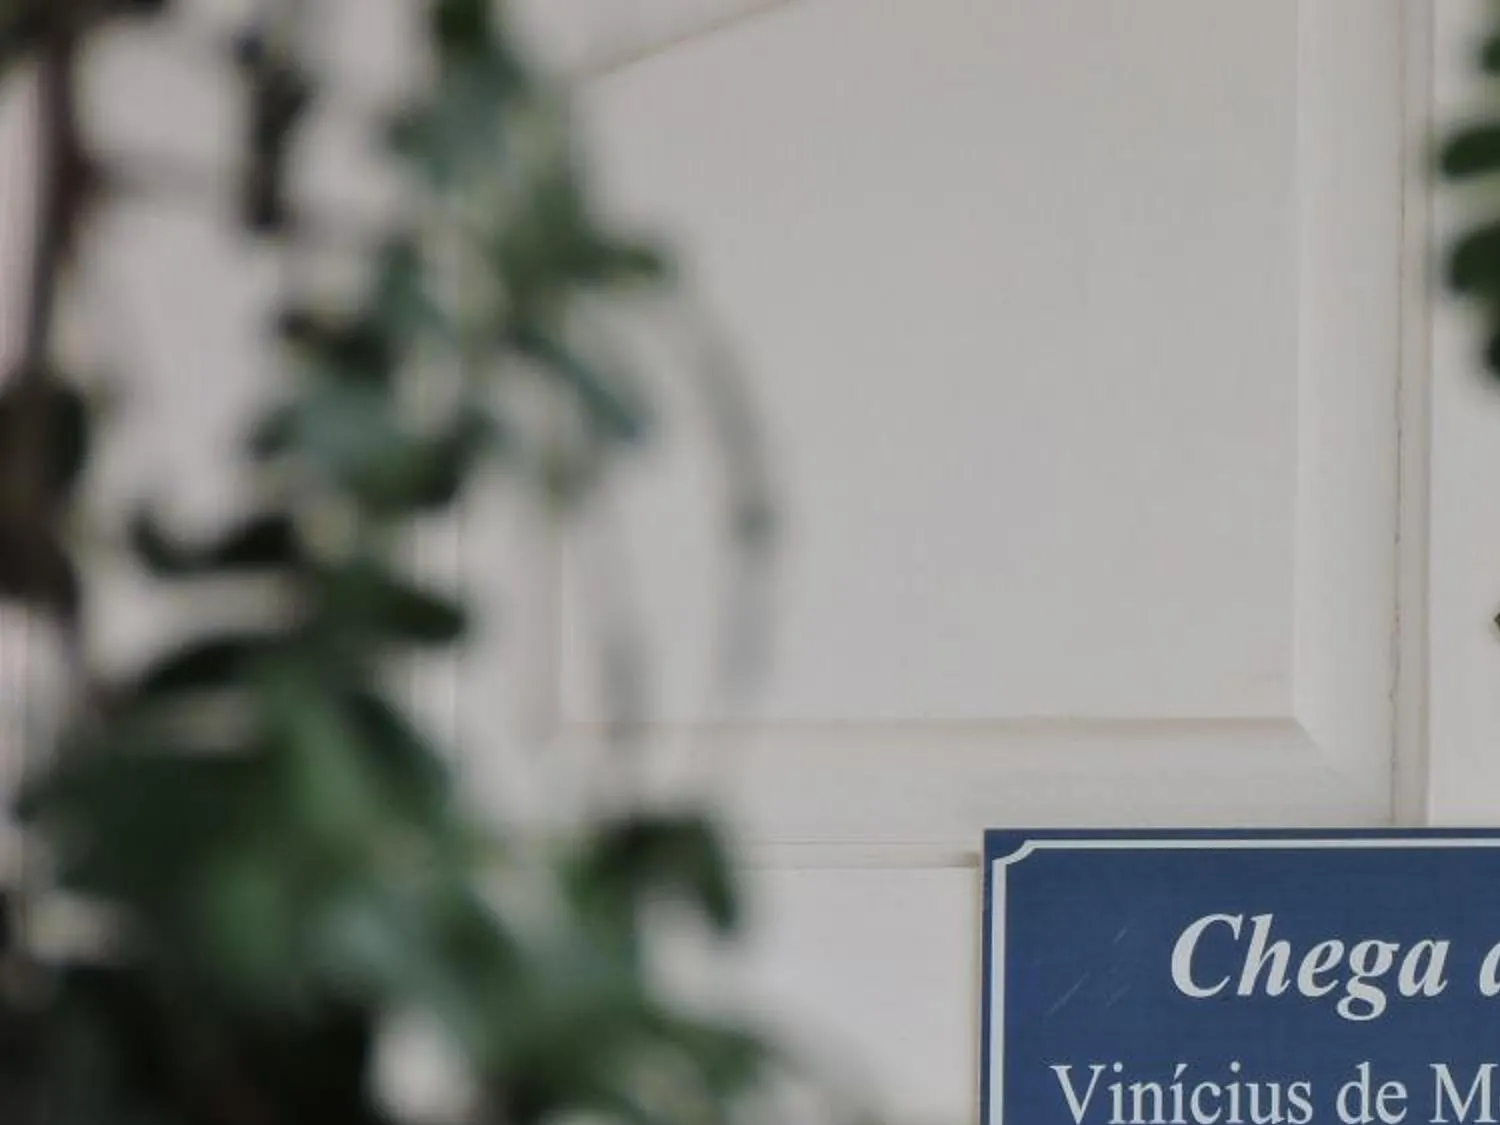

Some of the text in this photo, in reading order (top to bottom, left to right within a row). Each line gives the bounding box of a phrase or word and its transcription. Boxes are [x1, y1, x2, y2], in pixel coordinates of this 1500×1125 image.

[1169, 911, 1450, 1022] Chega
[1050, 1061, 1314, 1125] Vinícius
[1336, 1060, 1408, 1125] de
